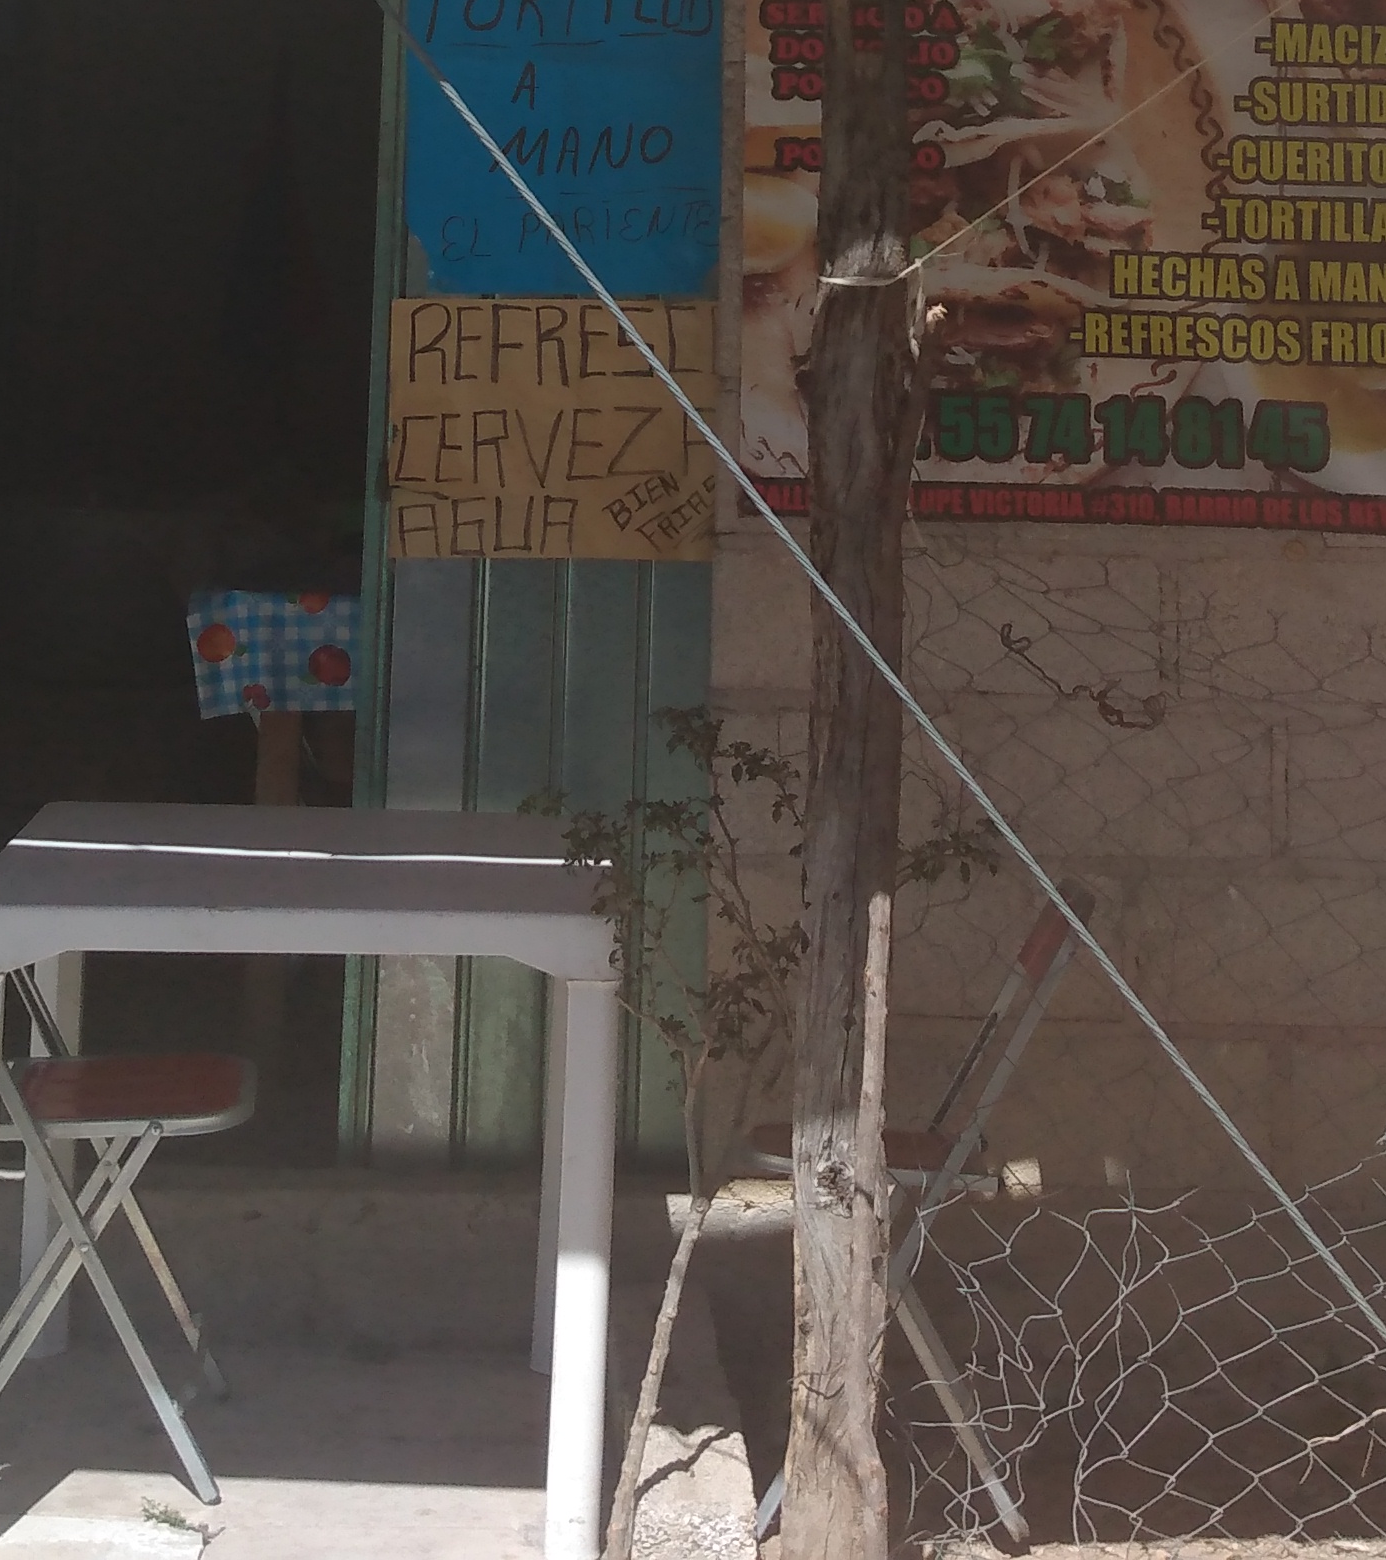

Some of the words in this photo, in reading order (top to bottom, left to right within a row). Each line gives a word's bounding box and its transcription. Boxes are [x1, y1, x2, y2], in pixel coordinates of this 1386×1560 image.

[511, 59, 539, 110] A
[778, 71, 824, 101] PO
[488, 123, 674, 176] MANO
[781, 142, 823, 167] PO
[1112, 253, 1266, 301] HECHAS
[1273, 259, 1301, 301] A
[409, 302, 715, 388] REFRESC
[1069, 312, 1301, 363] -REFRESCOS
[936, 395, 1014, 460] 55
[1023, 395, 1090, 462] 74
[1096, 396, 1165, 466] 14
[1171, 396, 1244, 468] 81
[1247, 401, 1329, 471] 45
[601, 471, 681, 532] BIEN
[760, 483, 810, 510] ALL
[968, 488, 1085, 518] VICTORIA
[1164, 494, 1259, 522] BARRIO
[1263, 497, 1293, 524] DE
[1298, 499, 1343, 527] LOS
[397, 494, 579, 557] AGUA
